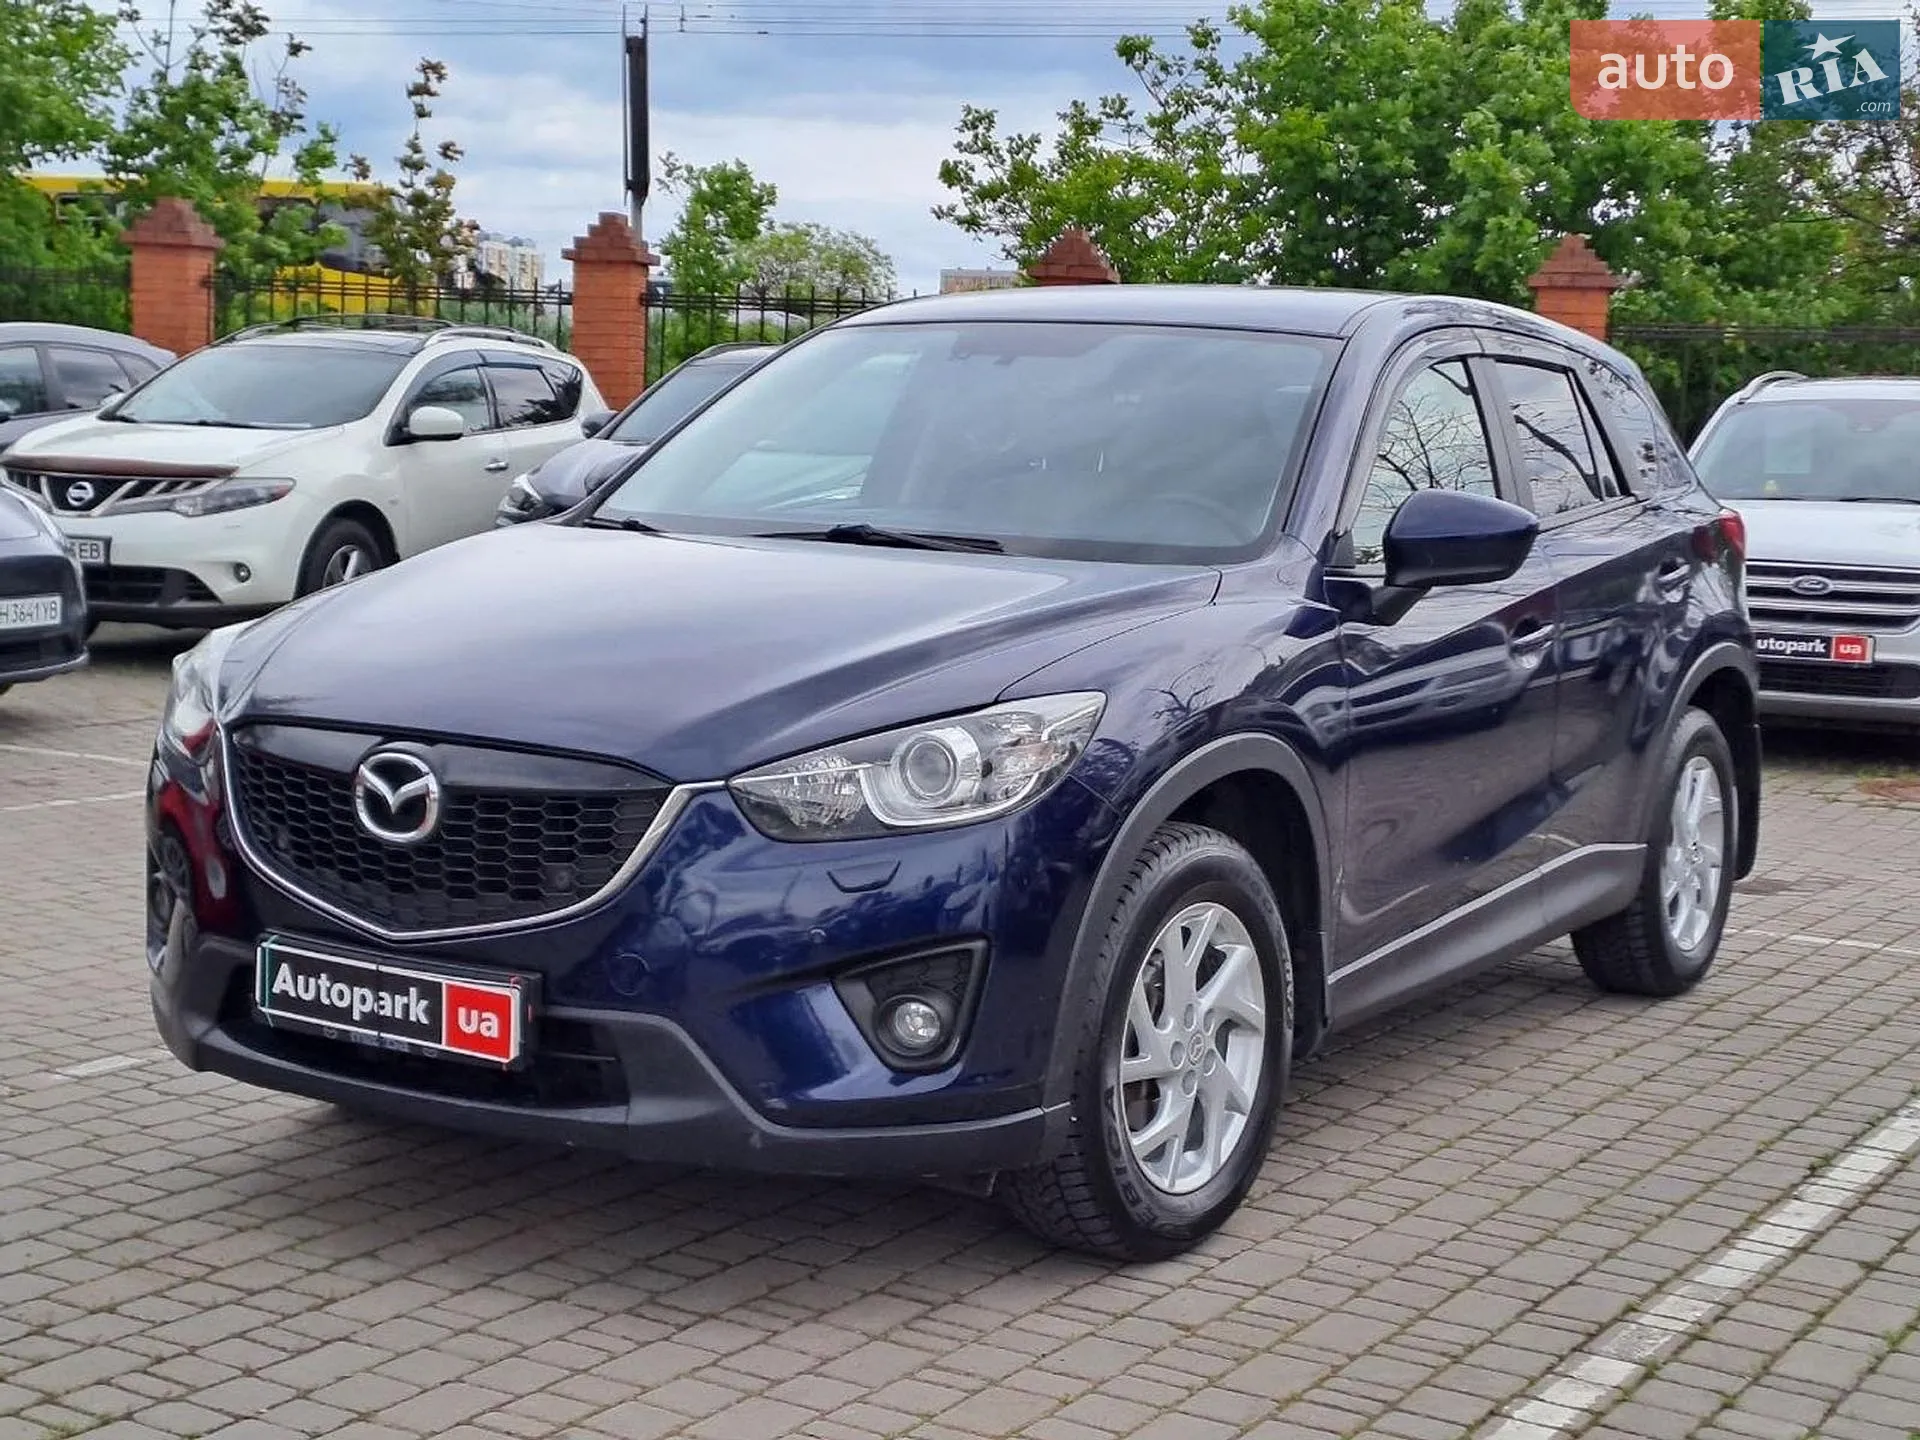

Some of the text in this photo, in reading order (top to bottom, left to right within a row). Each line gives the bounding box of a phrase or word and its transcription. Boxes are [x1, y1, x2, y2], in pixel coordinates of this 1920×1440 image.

[1756, 638, 1862, 655] utopark ua
[272, 962, 499, 1038] Autopark ua
